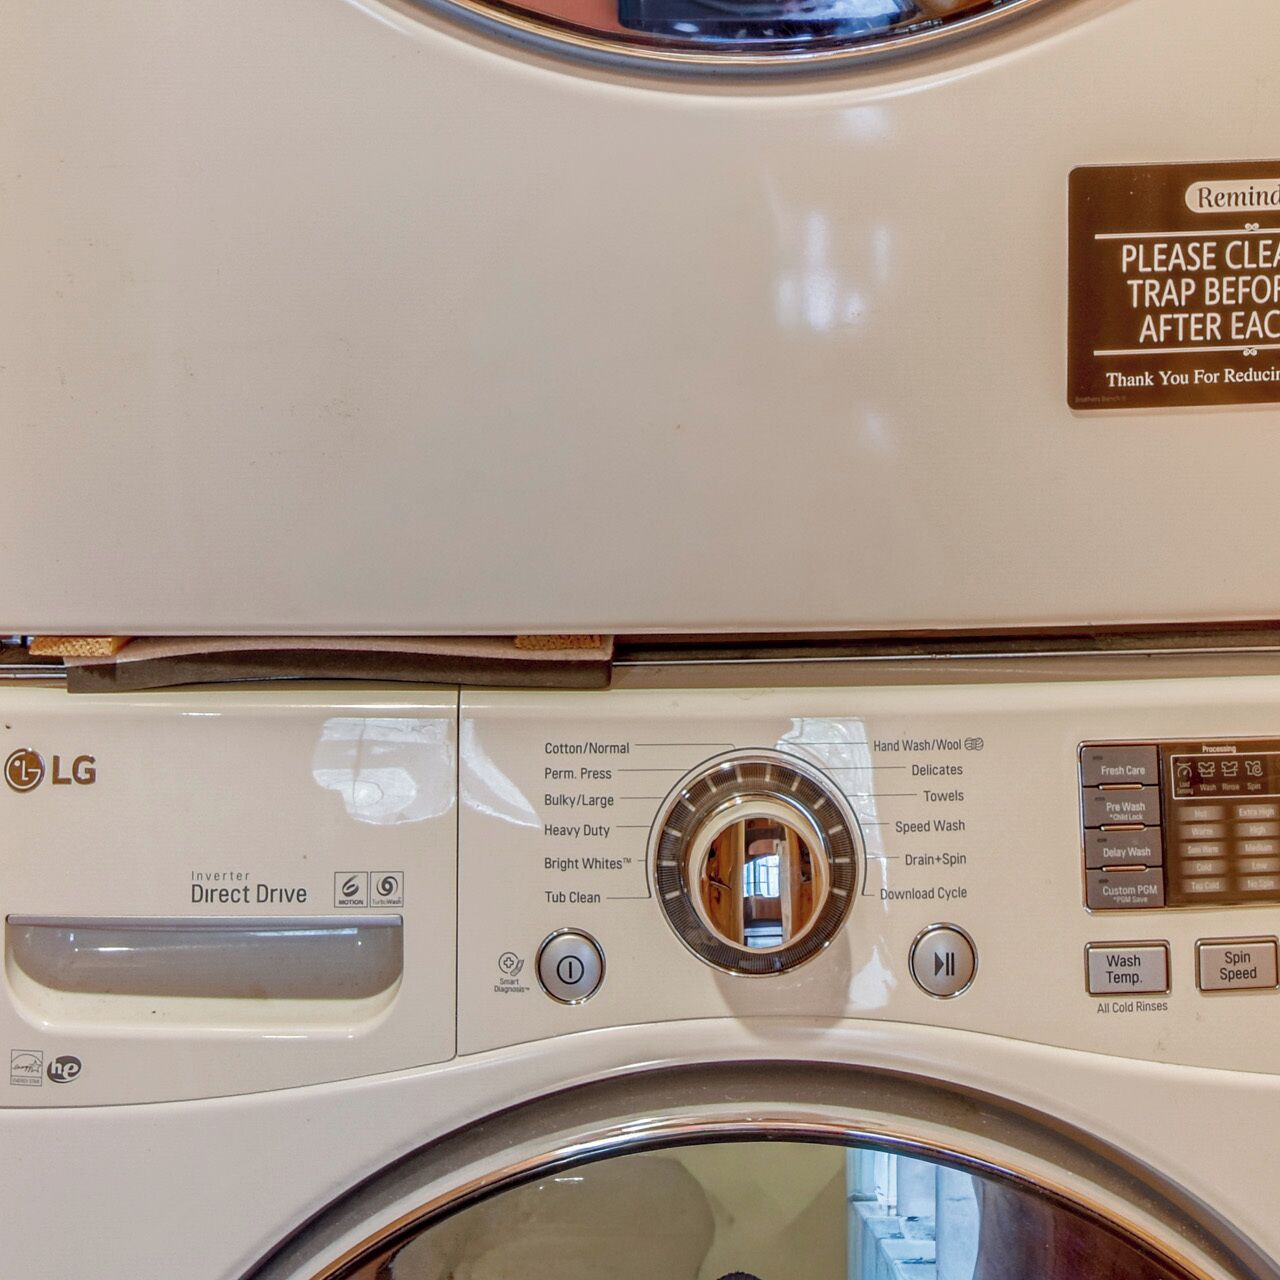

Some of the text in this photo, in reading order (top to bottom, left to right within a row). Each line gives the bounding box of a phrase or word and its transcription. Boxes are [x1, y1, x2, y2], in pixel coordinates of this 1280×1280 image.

[1122, 241, 1217, 273] PLEASE
[1127, 278, 1196, 308] TRAP
[1139, 312, 1222, 344] AFTER
[1106, 371, 1154, 388] Thank
[1158, 370, 1190, 387] You
[1193, 369, 1220, 385] For
[544, 742, 630, 754] Cotton/Normal
[873, 739, 962, 752] Hand Wash/Wool
[1202, 744, 1237, 754] Processing
[52, 755, 97, 785] LG
[544, 767, 612, 780] Perm. Press
[911, 764, 963, 776] Delicates
[1100, 765, 1146, 776] Fresh Care
[544, 793, 615, 809] Bulky/Large
[923, 790, 965, 802] Towels
[1106, 801, 1146, 812] Pre Wash
[544, 824, 610, 839] Heavy Duty
[895, 819, 966, 834] Speed Wash
[905, 852, 967, 867] Drain+Spin
[1103, 846, 1151, 859] Delay Wash
[544, 857, 580, 872] Bright
[191, 870, 251, 881] Inverter
[191, 883, 308, 904] Direct Drive
[545, 891, 601, 903] Tub Clean
[880, 886, 968, 901] Download Cycle
[1102, 884, 1158, 896] Custom PGM
[1106, 954, 1141, 967] Wash
[1224, 950, 1251, 966] Spin
[1106, 970, 1143, 986] Temp.
[1219, 966, 1257, 982] Speed
[499, 977, 519, 986] Smart
[1097, 1000, 1169, 1014] All Cold Rinses
